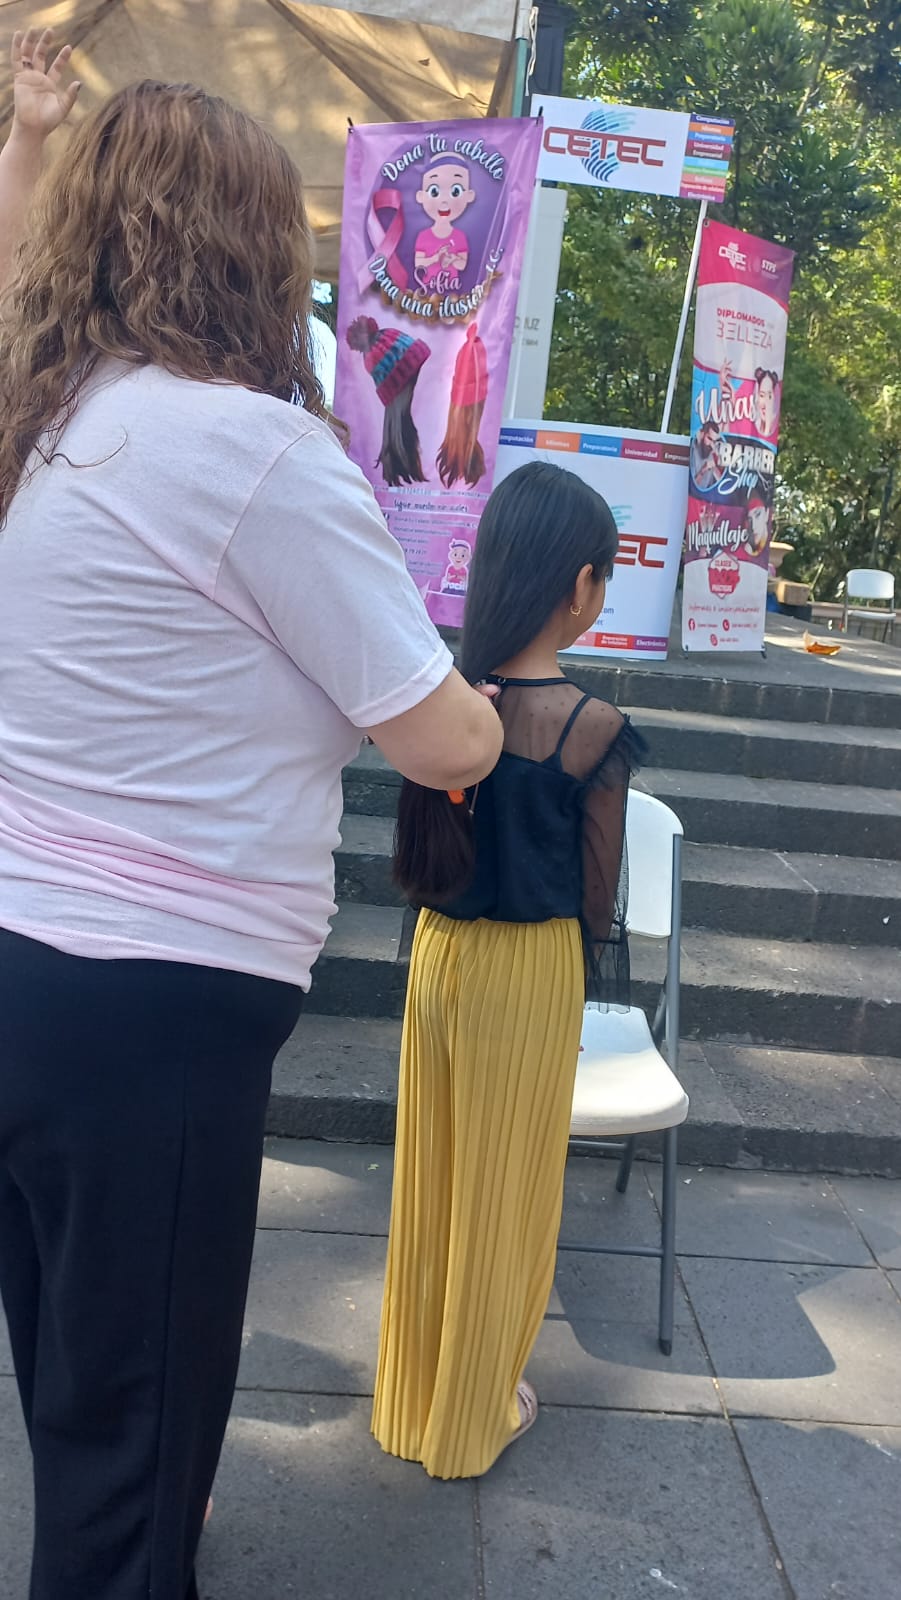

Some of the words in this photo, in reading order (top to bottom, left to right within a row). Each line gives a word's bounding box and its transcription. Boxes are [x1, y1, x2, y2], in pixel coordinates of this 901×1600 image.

[382, 144, 424, 182] Dona
[425, 133, 447, 151] tu
[454, 138, 506, 180] cabello
[543, 126, 666, 167] CETEC
[368, 256, 403, 300] Dona
[401, 294, 433, 317] una
[717, 307, 765, 327] DIPLOMADOS
[716, 320, 773, 351] BELLEZA
[695, 388, 756, 424] Uñas
[499, 435, 534, 444] omputación
[625, 448, 658, 459] Universidad
[719, 442, 775, 475] BARBER
[688, 519, 749, 552] Maquillaje
